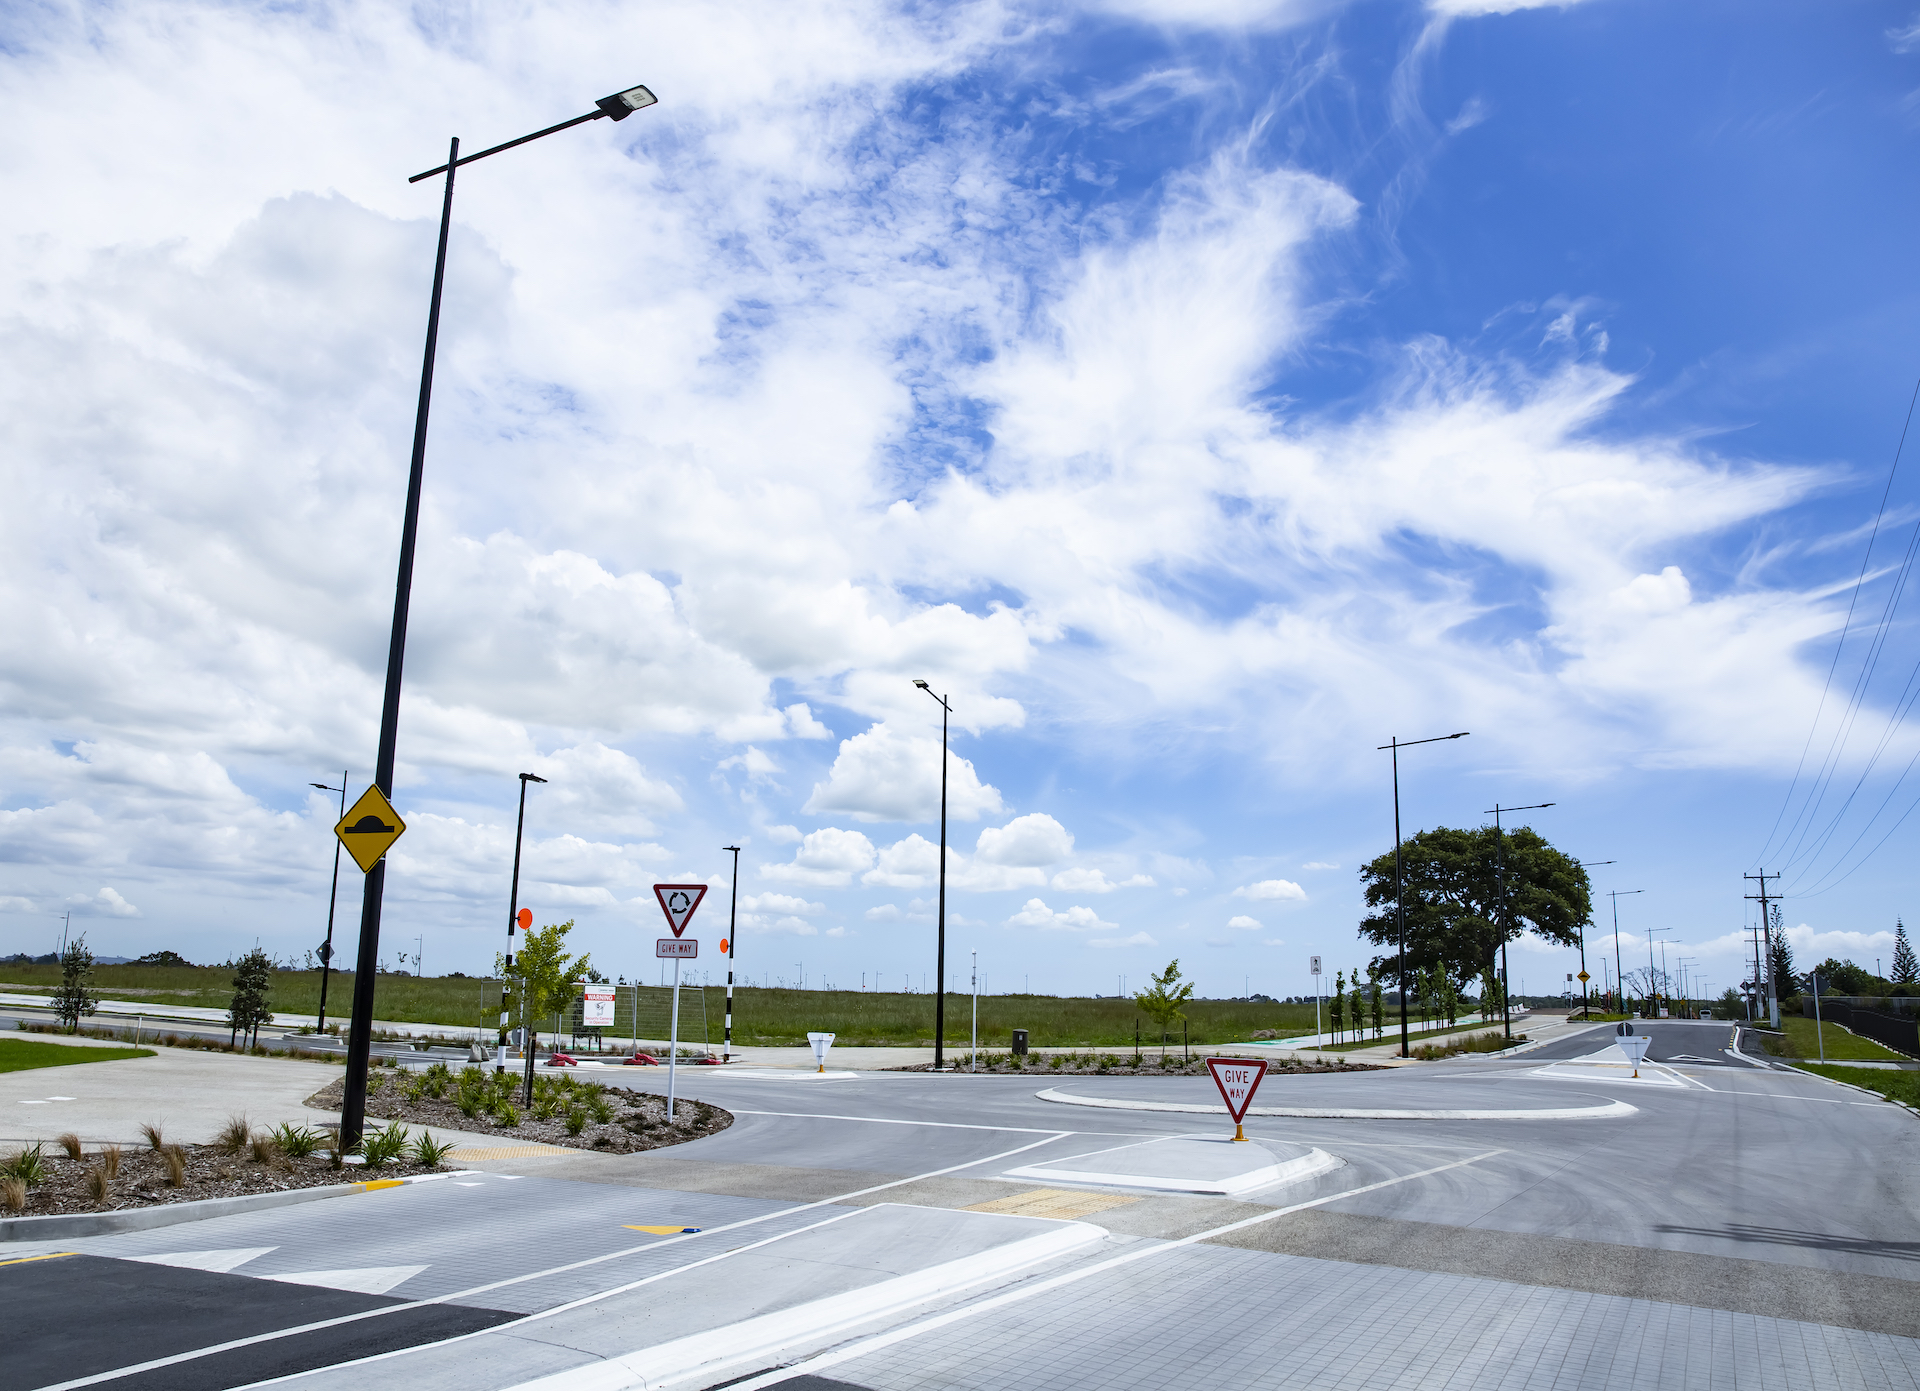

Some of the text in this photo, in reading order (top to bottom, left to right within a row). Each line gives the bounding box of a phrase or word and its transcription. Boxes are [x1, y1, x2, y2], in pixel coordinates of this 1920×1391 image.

[661, 943, 692, 953] GIVE WAY
[1225, 1070, 1249, 1084] GIVE
[1230, 1088, 1244, 1098] WAY
